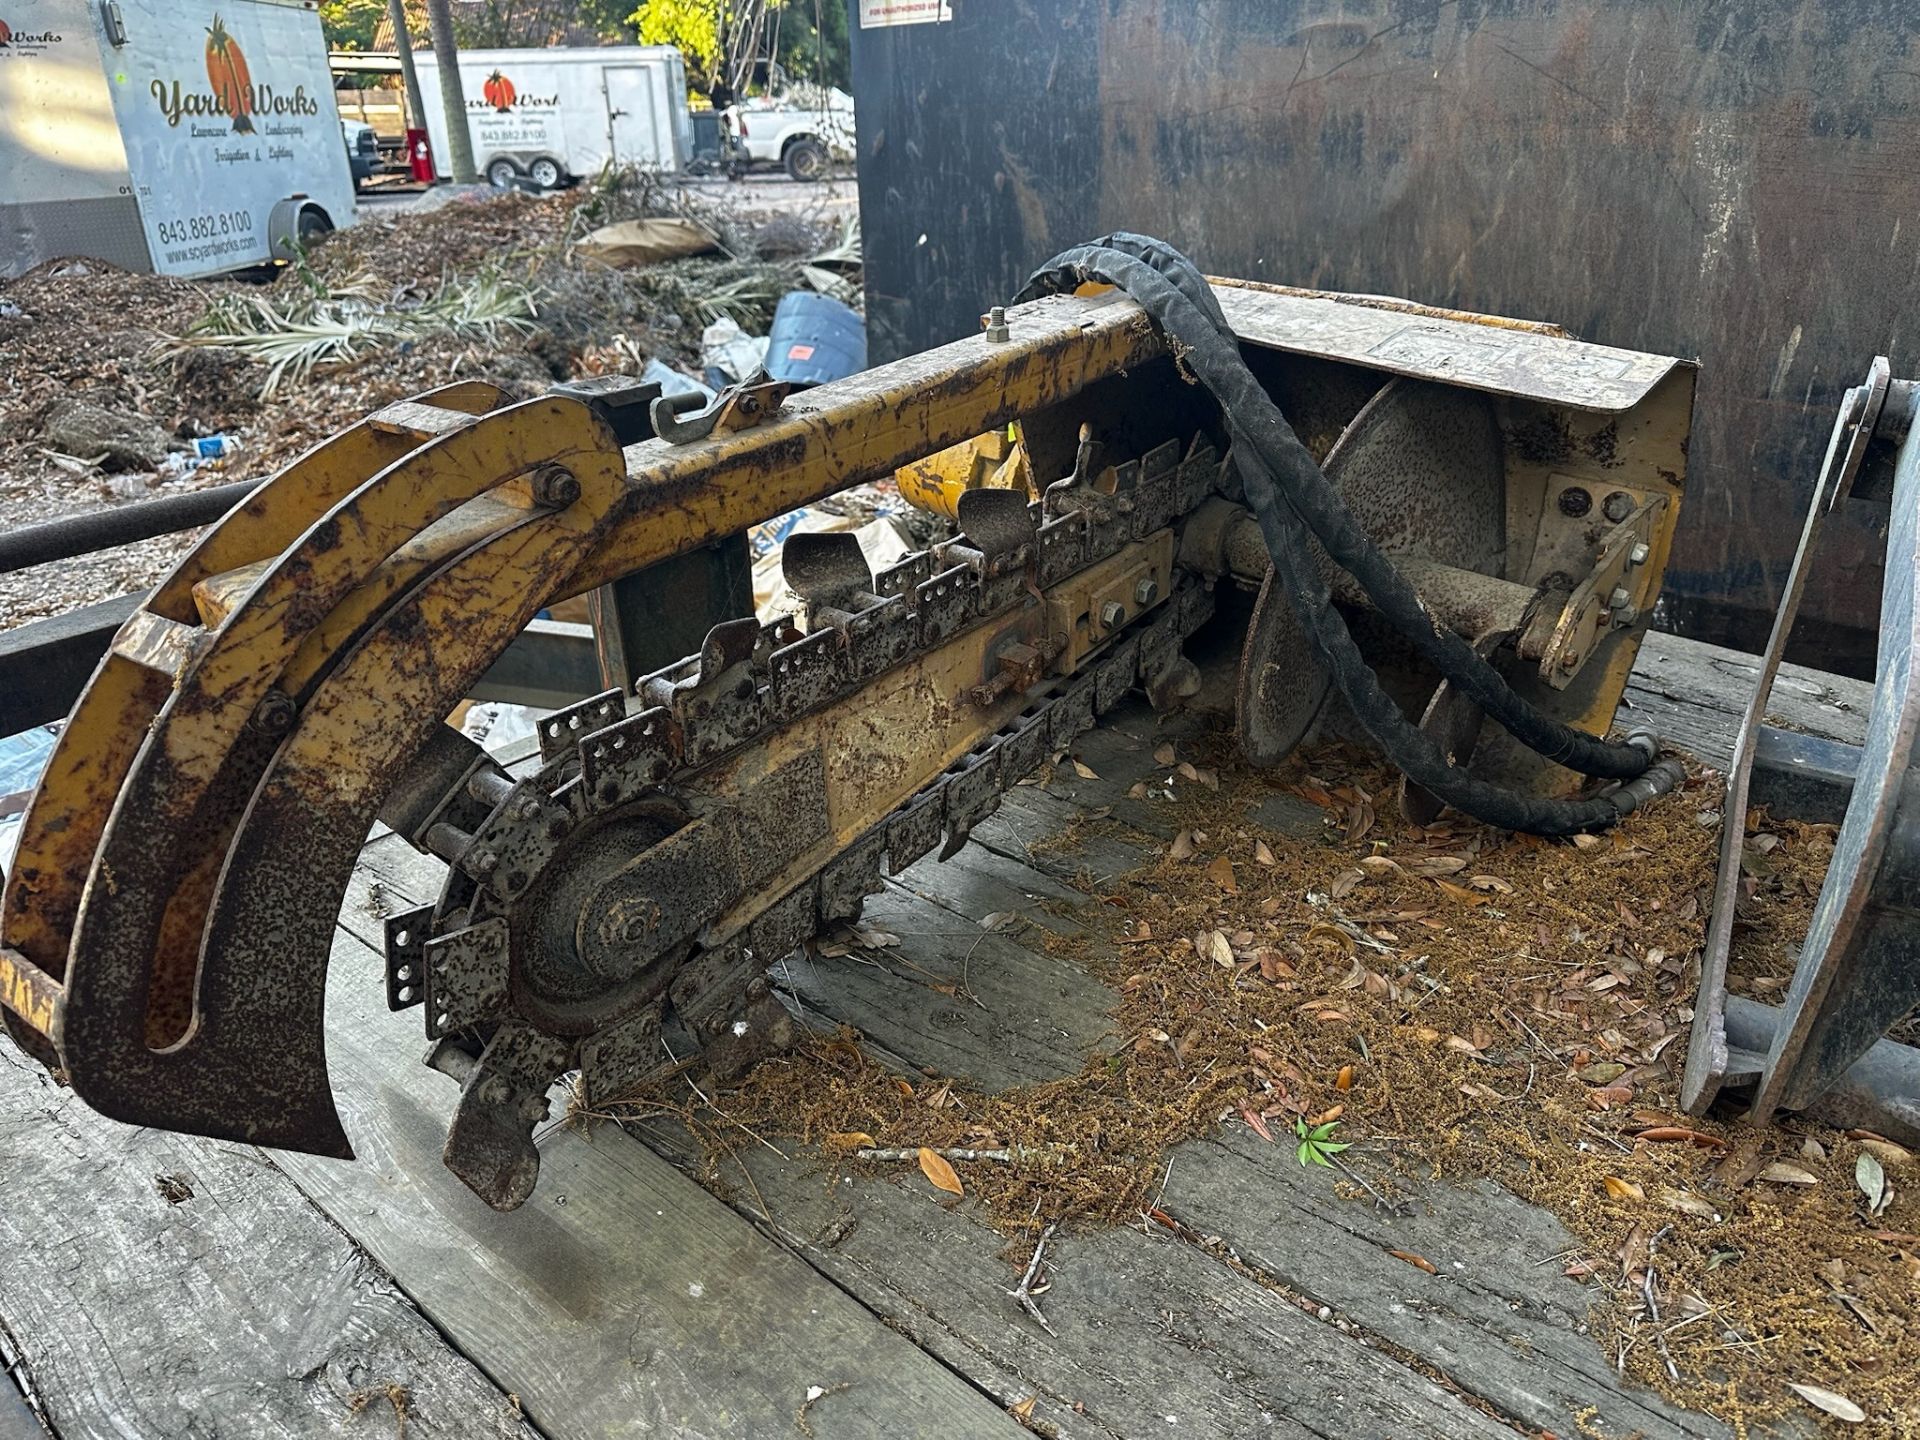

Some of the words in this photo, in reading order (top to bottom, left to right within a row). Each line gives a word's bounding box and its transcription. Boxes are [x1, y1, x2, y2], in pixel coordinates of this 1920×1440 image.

[8, 31, 62, 43] Works
[150, 79, 233, 128] Yard
[245, 83, 318, 116] Works
[158, 210, 252, 245] 843.882.8100
